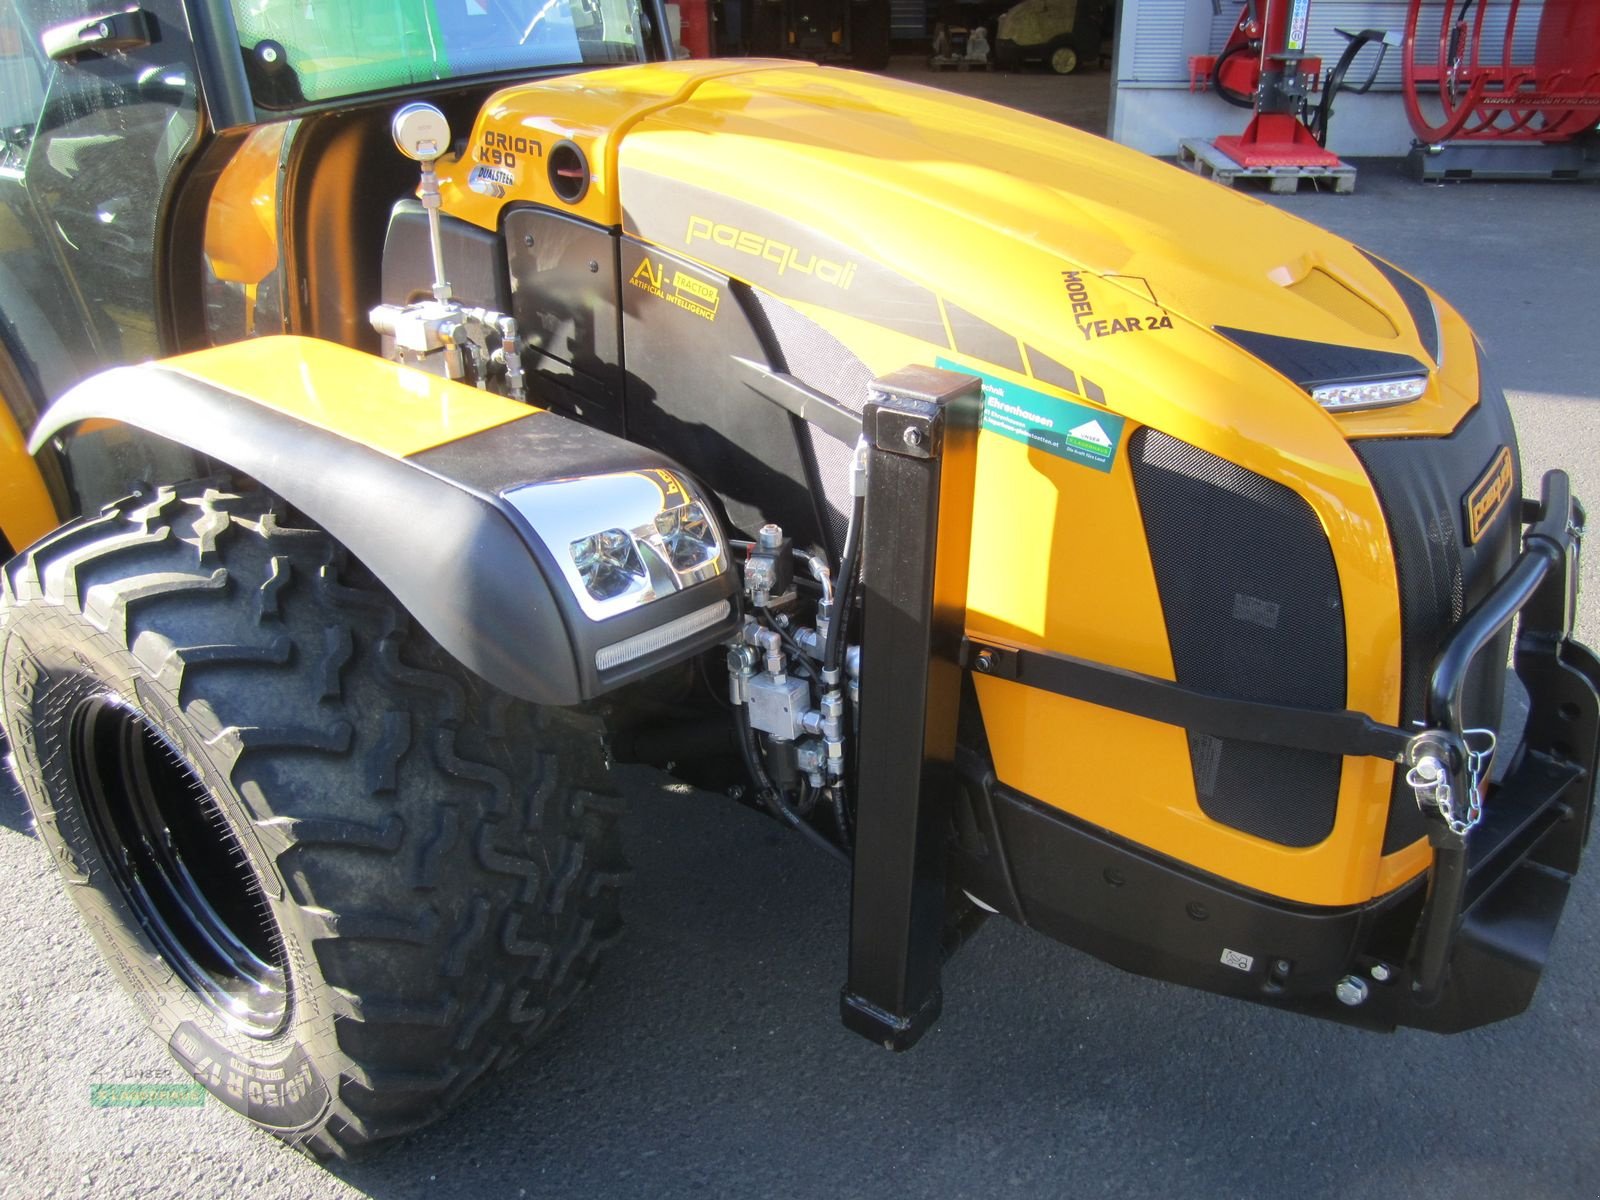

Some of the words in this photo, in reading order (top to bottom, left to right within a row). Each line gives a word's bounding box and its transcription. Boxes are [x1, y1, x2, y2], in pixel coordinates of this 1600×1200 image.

[484, 130, 543, 157] ORION
[480, 146, 516, 169] K90
[478, 167, 513, 186] DUALSTEER
[685, 214, 858, 291] pasquali
[629, 277, 665, 299] ARTIFICIAL
[665, 292, 716, 322] INTELLIGENCE
[676, 274, 715, 300] TRACTOR
[1061, 270, 1094, 325] MODEL
[1077, 316, 1144, 341] YEAR
[1145, 315, 1174, 330] 24
[981, 383, 1005, 398] echnik
[987, 396, 1054, 429] Ehrenhausen
[1080, 433, 1101, 442] UNSER
